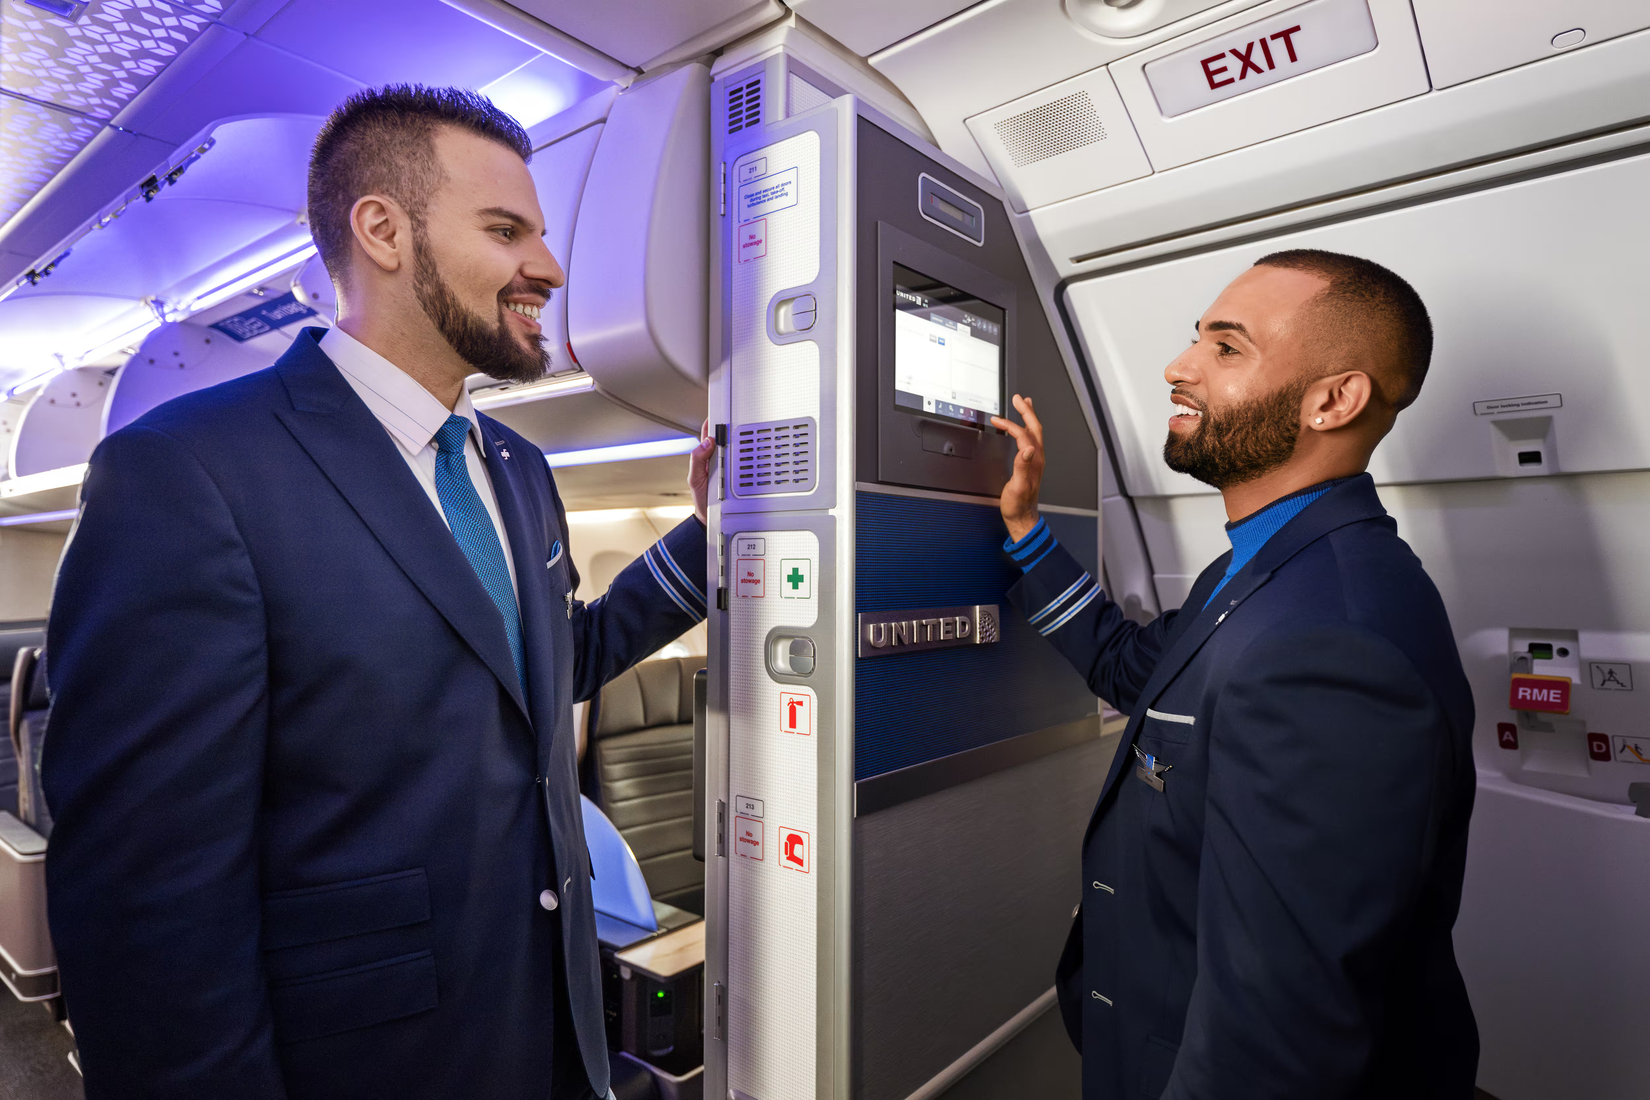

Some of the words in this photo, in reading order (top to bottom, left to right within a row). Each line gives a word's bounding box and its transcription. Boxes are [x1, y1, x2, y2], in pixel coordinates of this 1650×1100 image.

[1200, 25, 1301, 90] EXIT
[743, 239, 762, 248] stowage
[896, 290, 916, 302] UNITED
[869, 616, 971, 648] UNITED
[1518, 687, 1562, 702] RME
[1502, 731, 1514, 742] A
[1593, 741, 1606, 753] D
[739, 836, 759, 847] stowage
